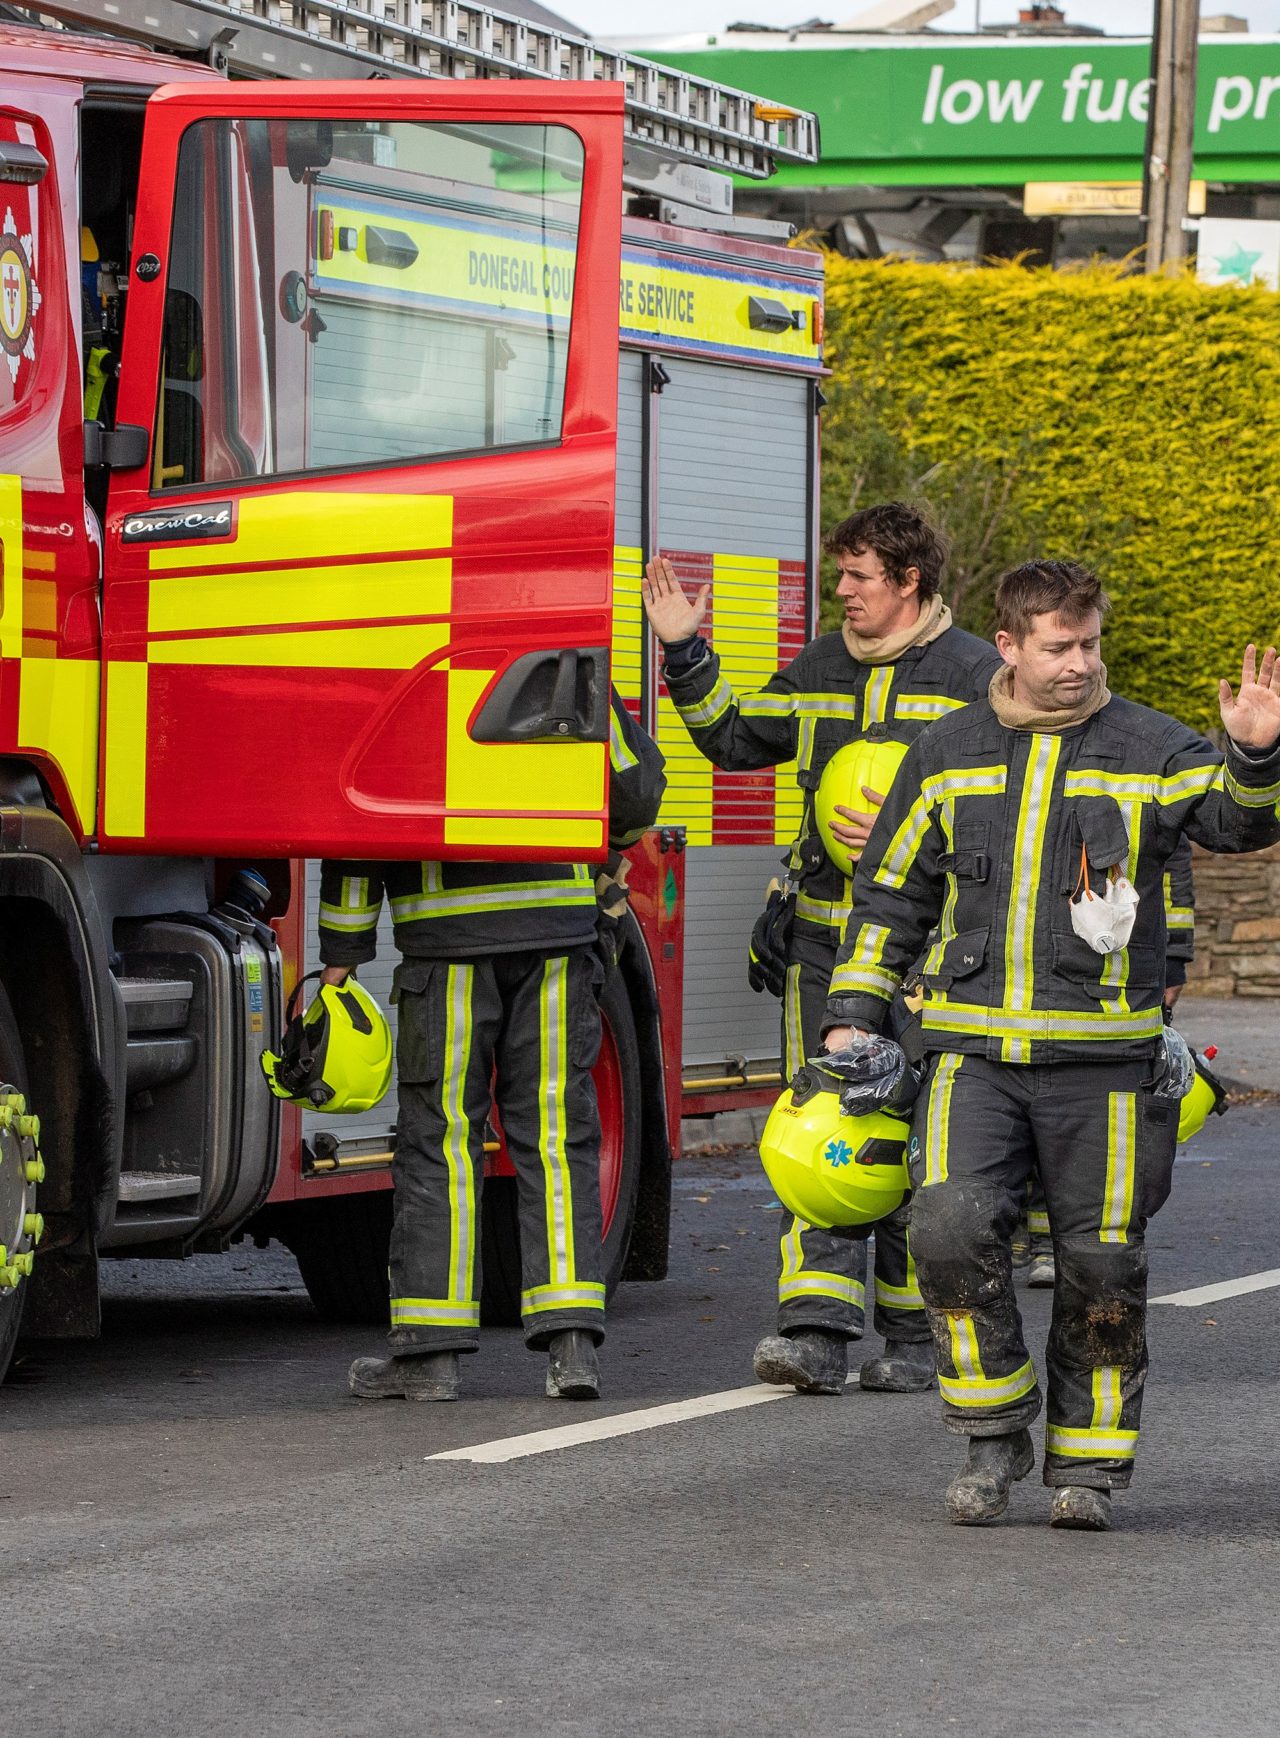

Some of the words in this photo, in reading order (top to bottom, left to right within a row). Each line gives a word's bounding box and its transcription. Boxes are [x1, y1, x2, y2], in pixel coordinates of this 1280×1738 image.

[921, 64, 1043, 124] low
[1062, 63, 1156, 123] fue
[469, 250, 538, 296] DONEGAL
[543, 264, 576, 301] COU
[620, 279, 633, 313] RE
[638, 281, 694, 324] SERVICE
